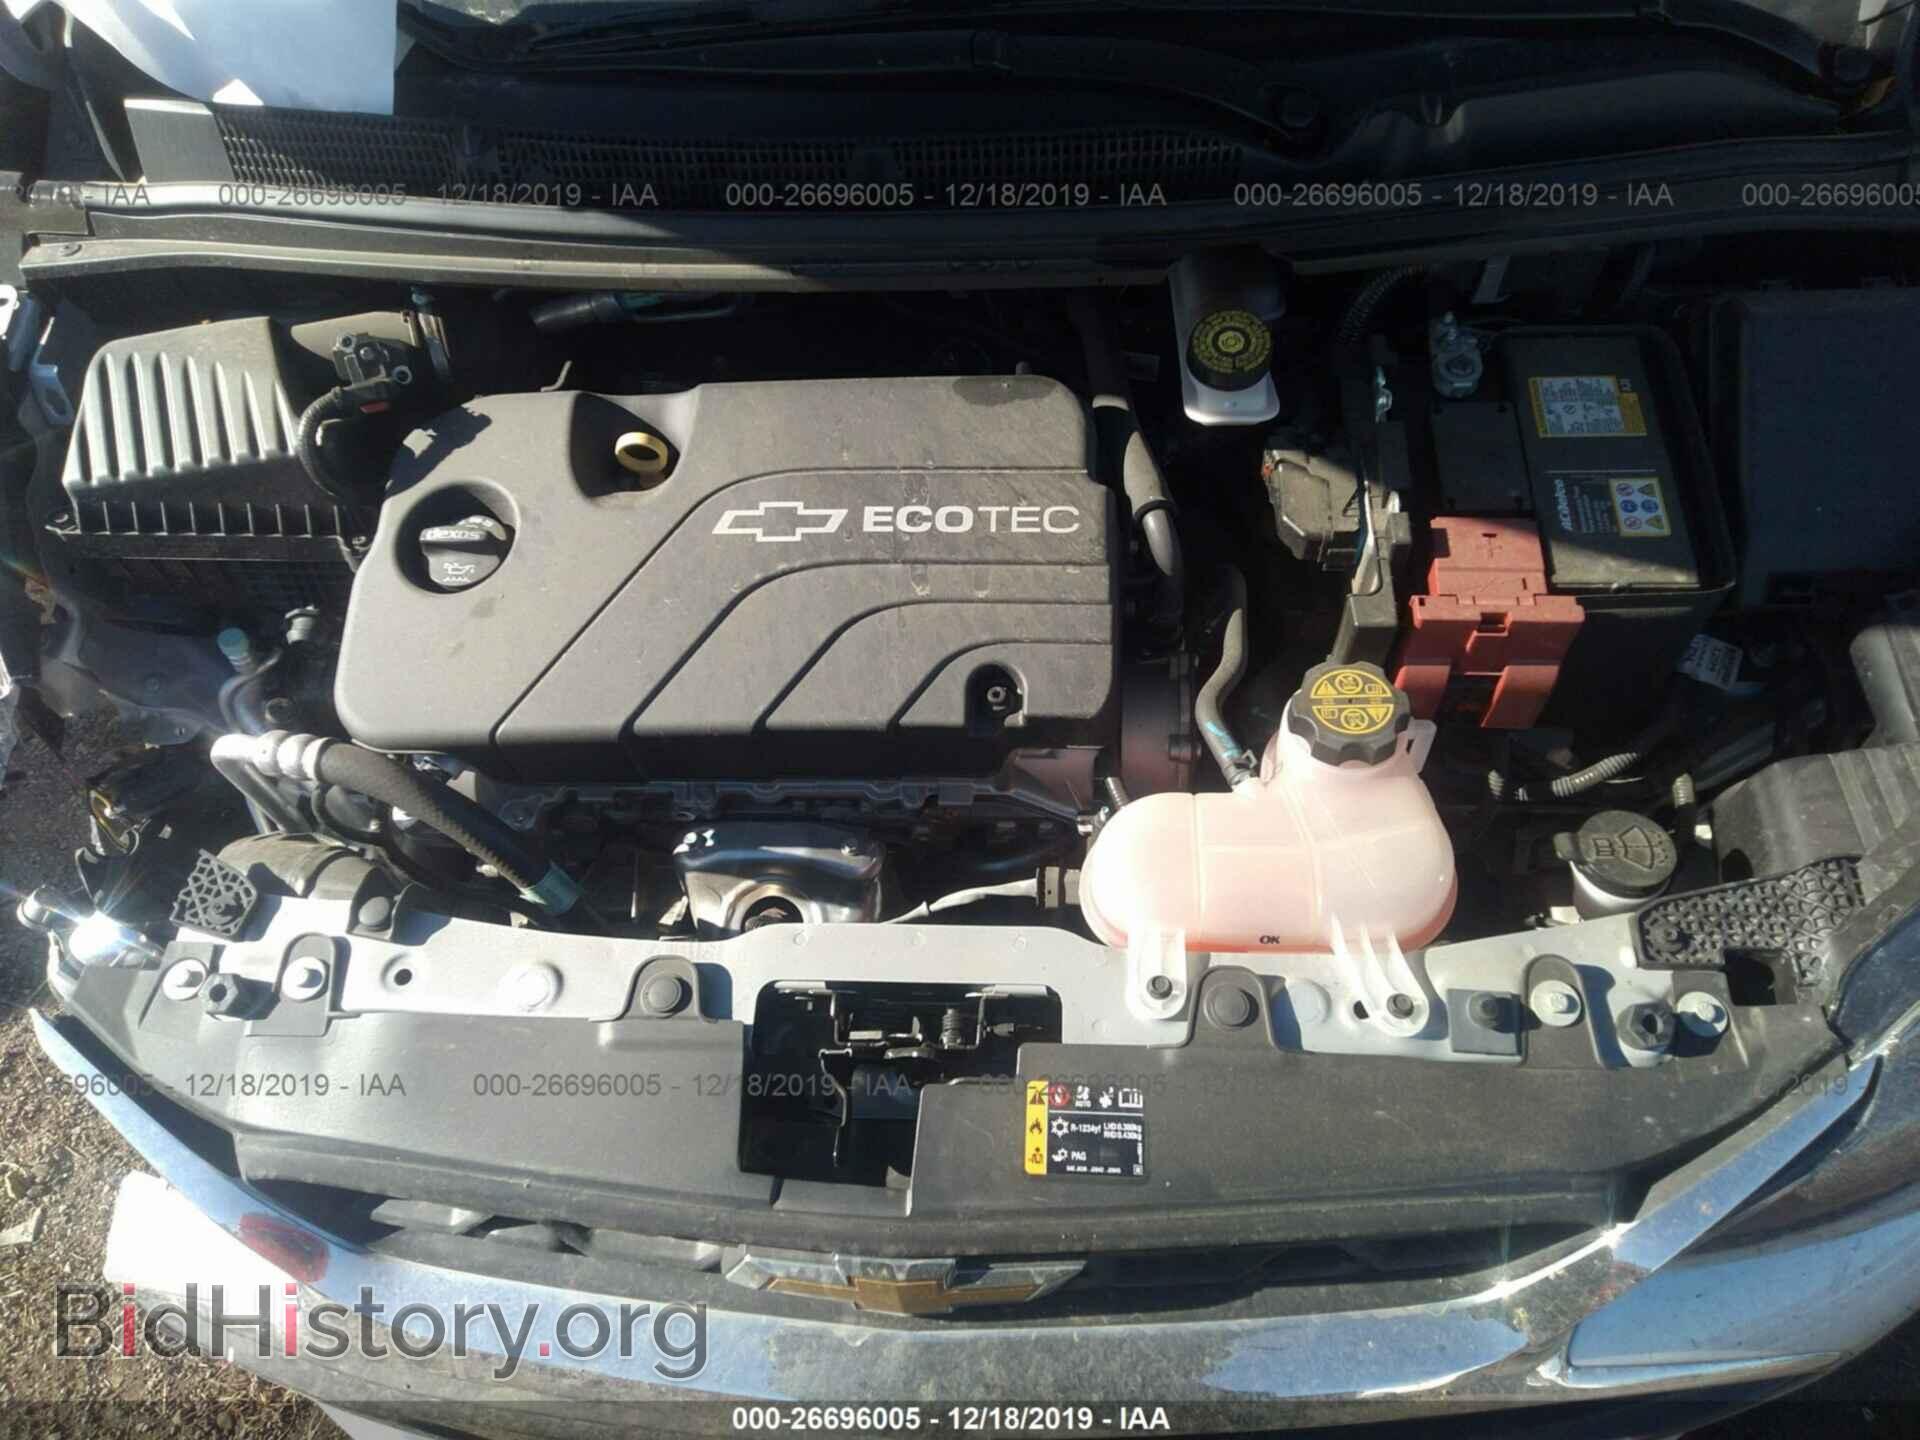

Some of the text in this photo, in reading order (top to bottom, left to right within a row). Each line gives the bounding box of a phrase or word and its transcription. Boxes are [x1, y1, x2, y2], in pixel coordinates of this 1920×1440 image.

[862, 504, 1081, 534] ECOTEC
[1259, 935, 1281, 945] OK
[1071, 1151, 1087, 1161] PAG
